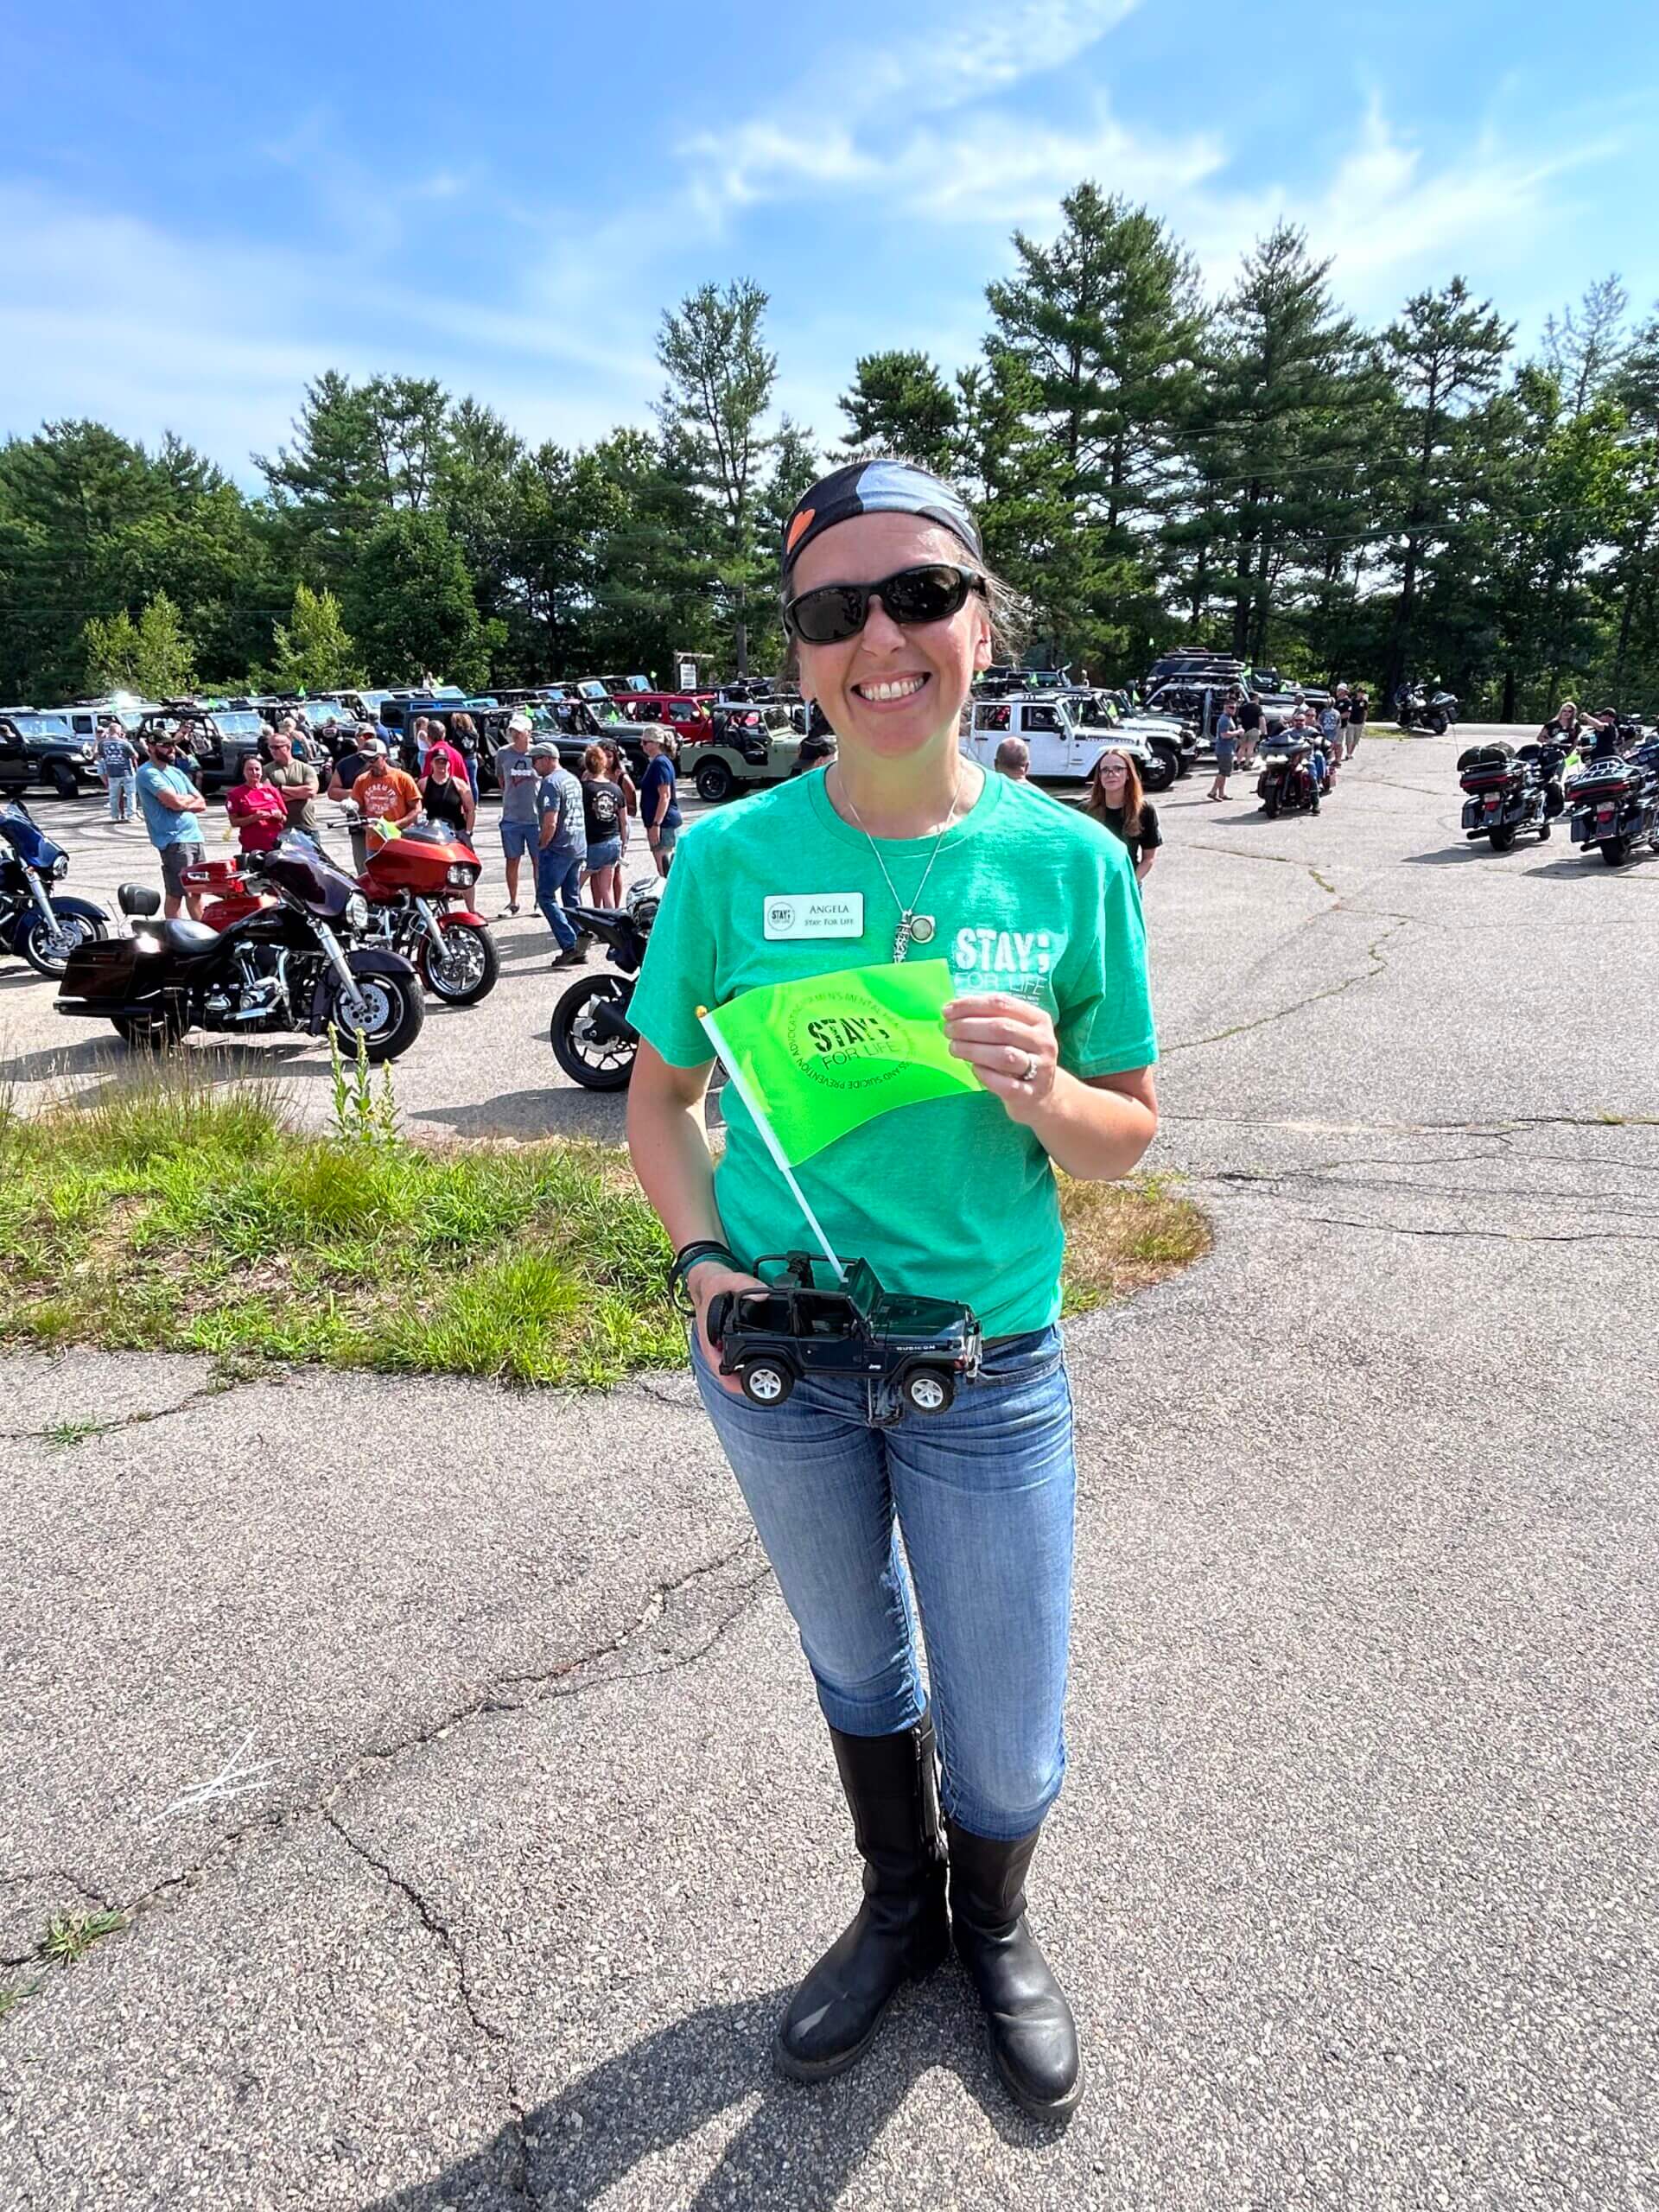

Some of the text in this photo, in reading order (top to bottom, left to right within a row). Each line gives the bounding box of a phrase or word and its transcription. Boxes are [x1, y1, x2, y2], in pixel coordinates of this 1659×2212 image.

[772, 909, 791, 920] STAY;
[809, 905, 849, 914] ANGELA
[955, 926, 1051, 974] STAY;
[953, 971, 1048, 995] FOR LIFE
[807, 1017, 890, 1052] STAY;
[822, 1047, 861, 1071] FOR
[863, 1041, 900, 1056] LIFE
[796, 1058, 845, 1090] PREVENTION
[848, 1077, 883, 1090] SUICIDE
[883, 1067, 901, 1081] AND
